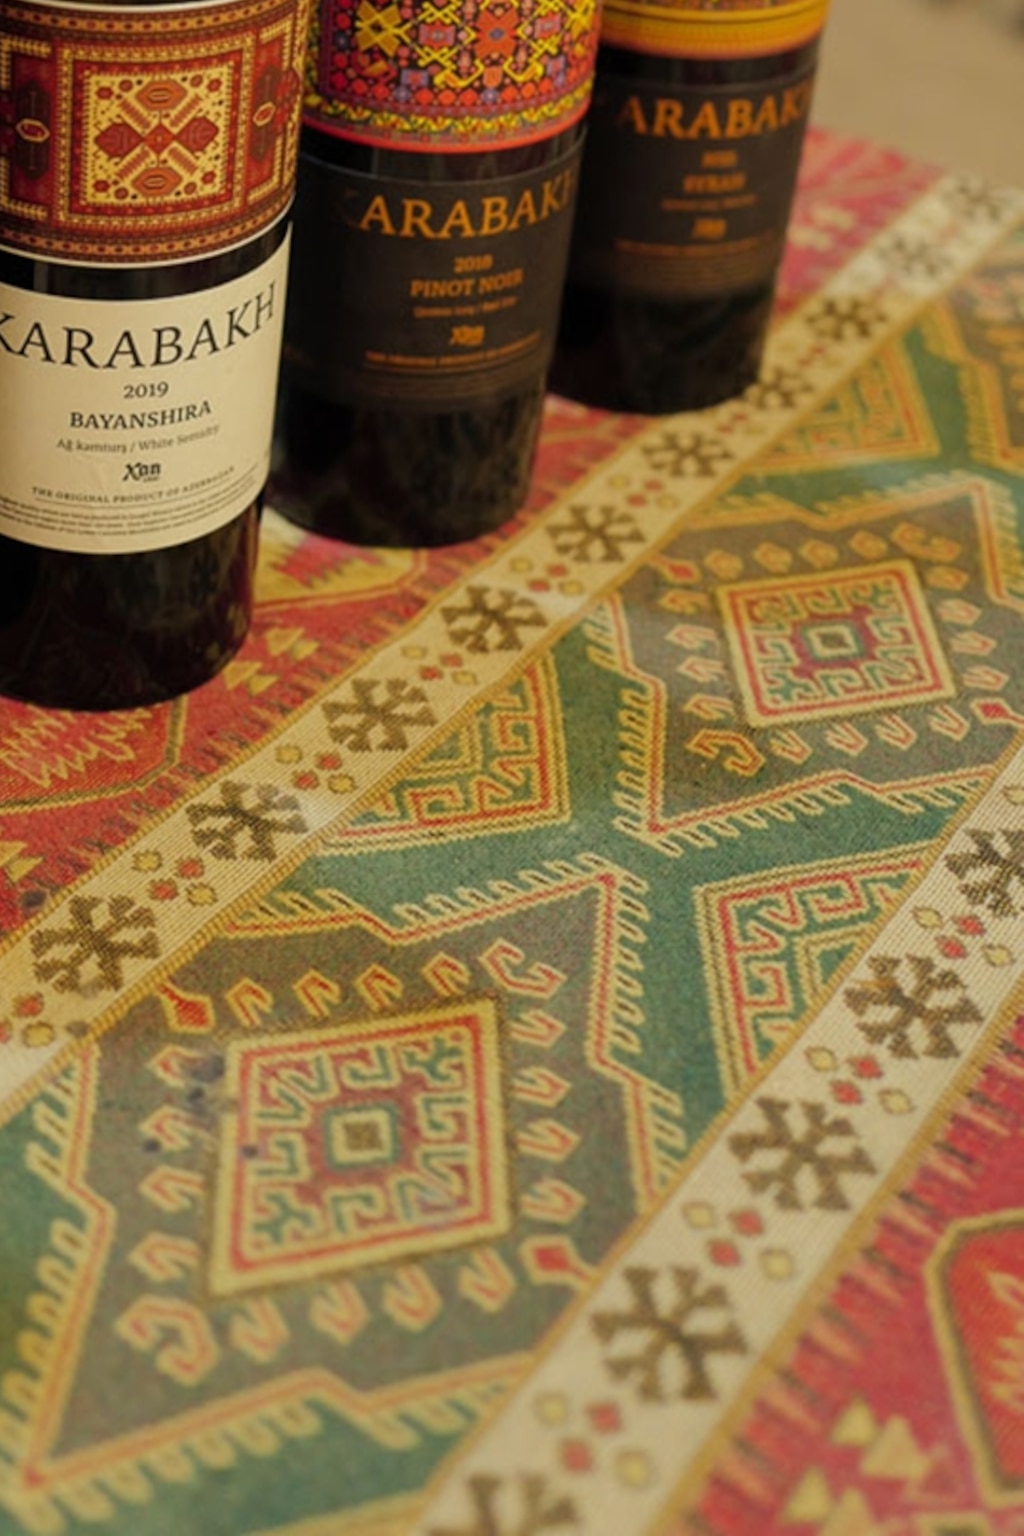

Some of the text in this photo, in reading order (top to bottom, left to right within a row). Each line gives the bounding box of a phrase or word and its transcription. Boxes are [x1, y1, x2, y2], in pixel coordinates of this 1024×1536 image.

[410, 268, 524, 298] PINOT NOIR
[123, 381, 169, 400] 2019
[70, 399, 212, 430] BAYANSHIRA
[138, 437, 174, 451] White
[32, 486, 53, 499] THE
[56, 489, 109, 504] ORIGINAL
[113, 491, 163, 504] PRODUCT
[166, 486, 180, 498] OF
